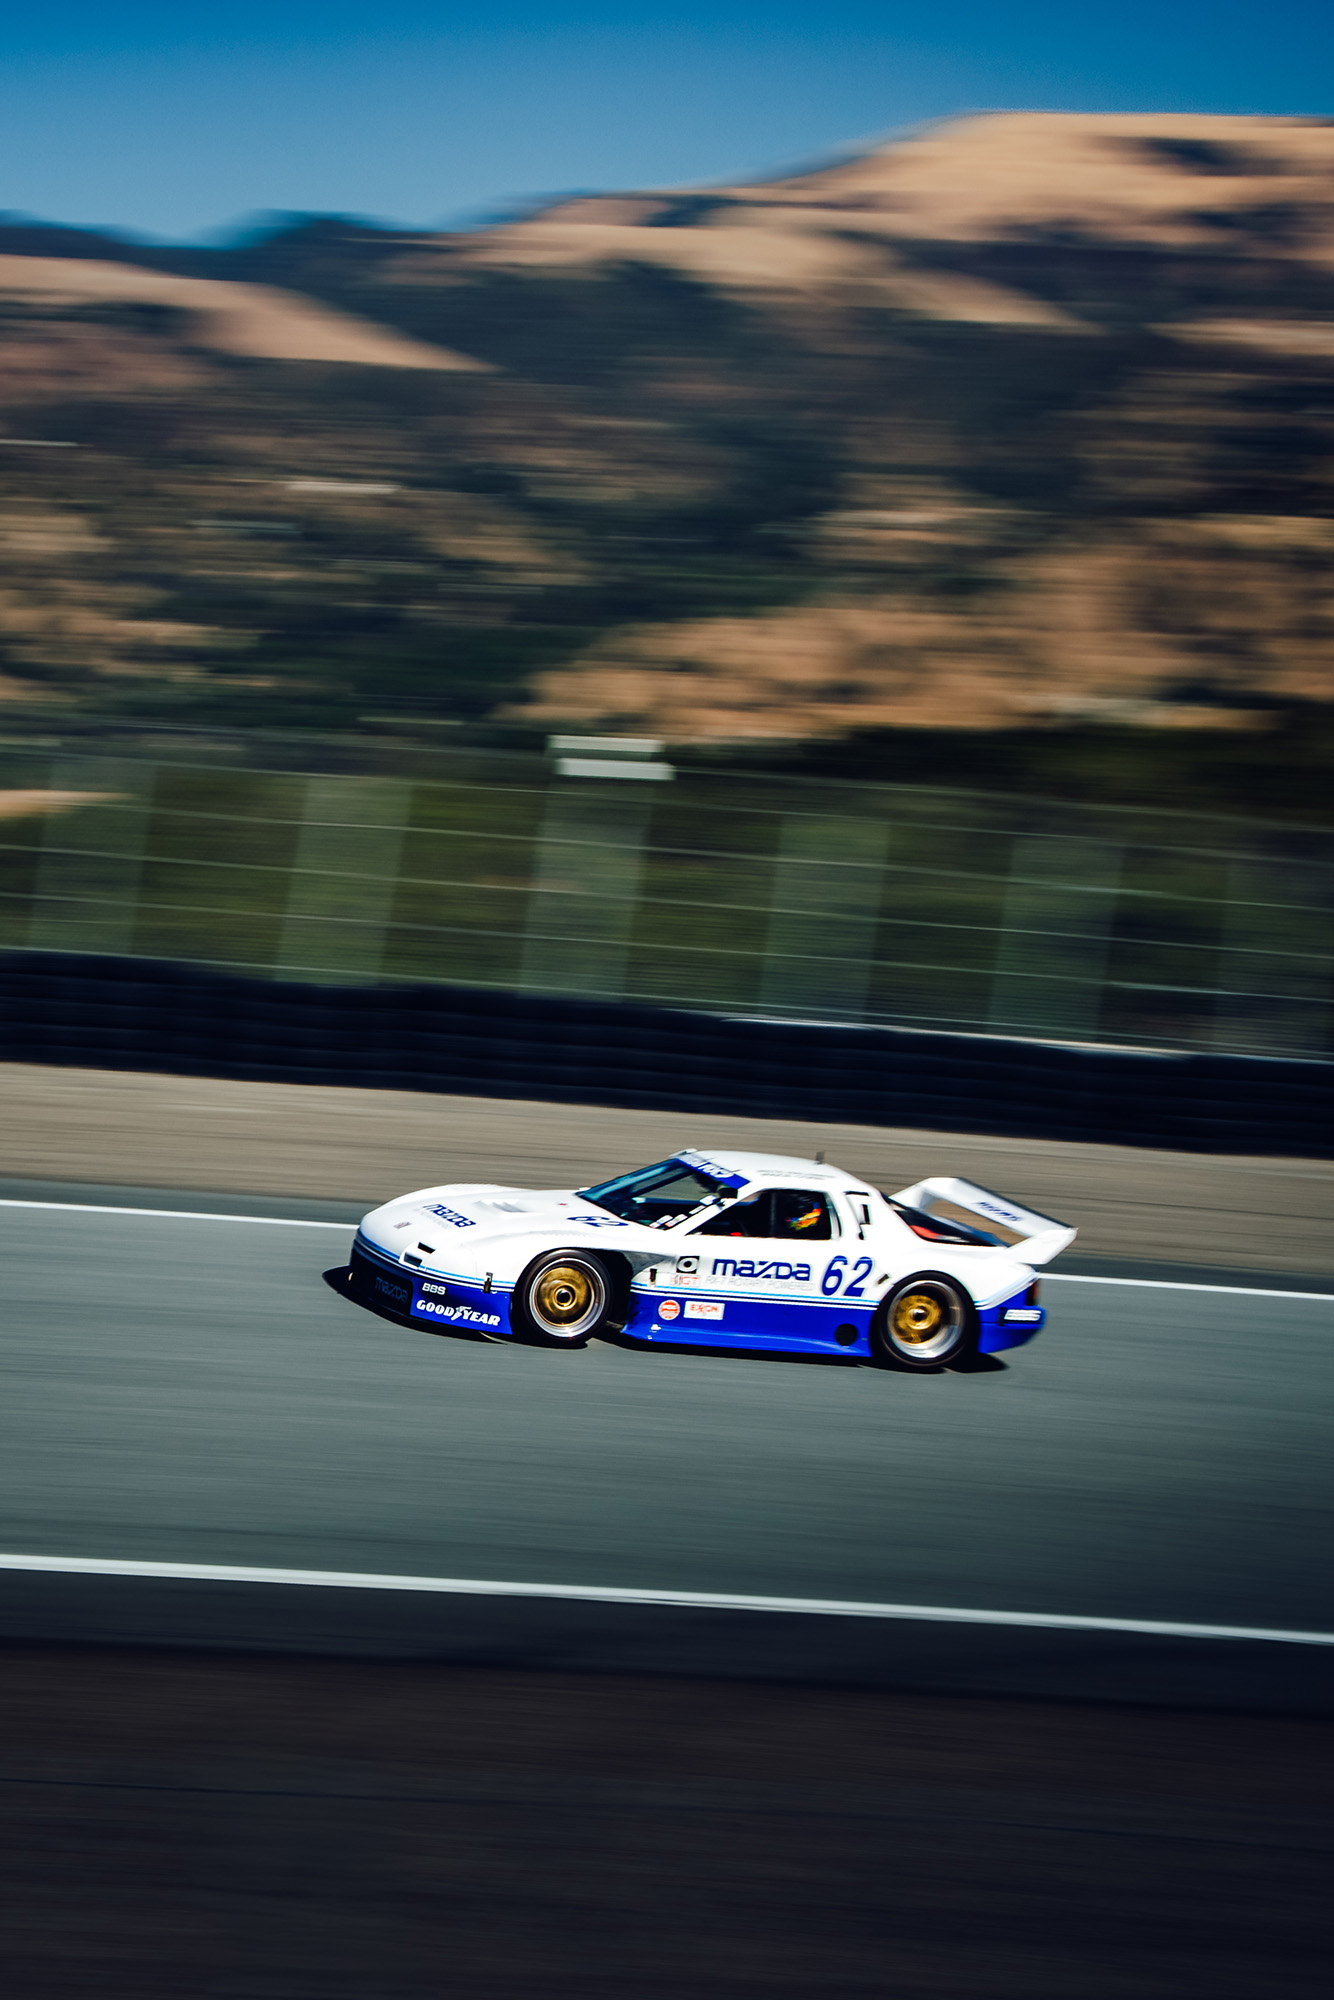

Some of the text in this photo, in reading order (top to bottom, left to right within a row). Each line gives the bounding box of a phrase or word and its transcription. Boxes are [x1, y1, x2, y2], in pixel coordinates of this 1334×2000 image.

[712, 1258, 810, 1281] mazda
[821, 1255, 873, 1297] 62
[422, 1282, 446, 1295] BBS
[416, 1299, 501, 1326] GOODYEAR
